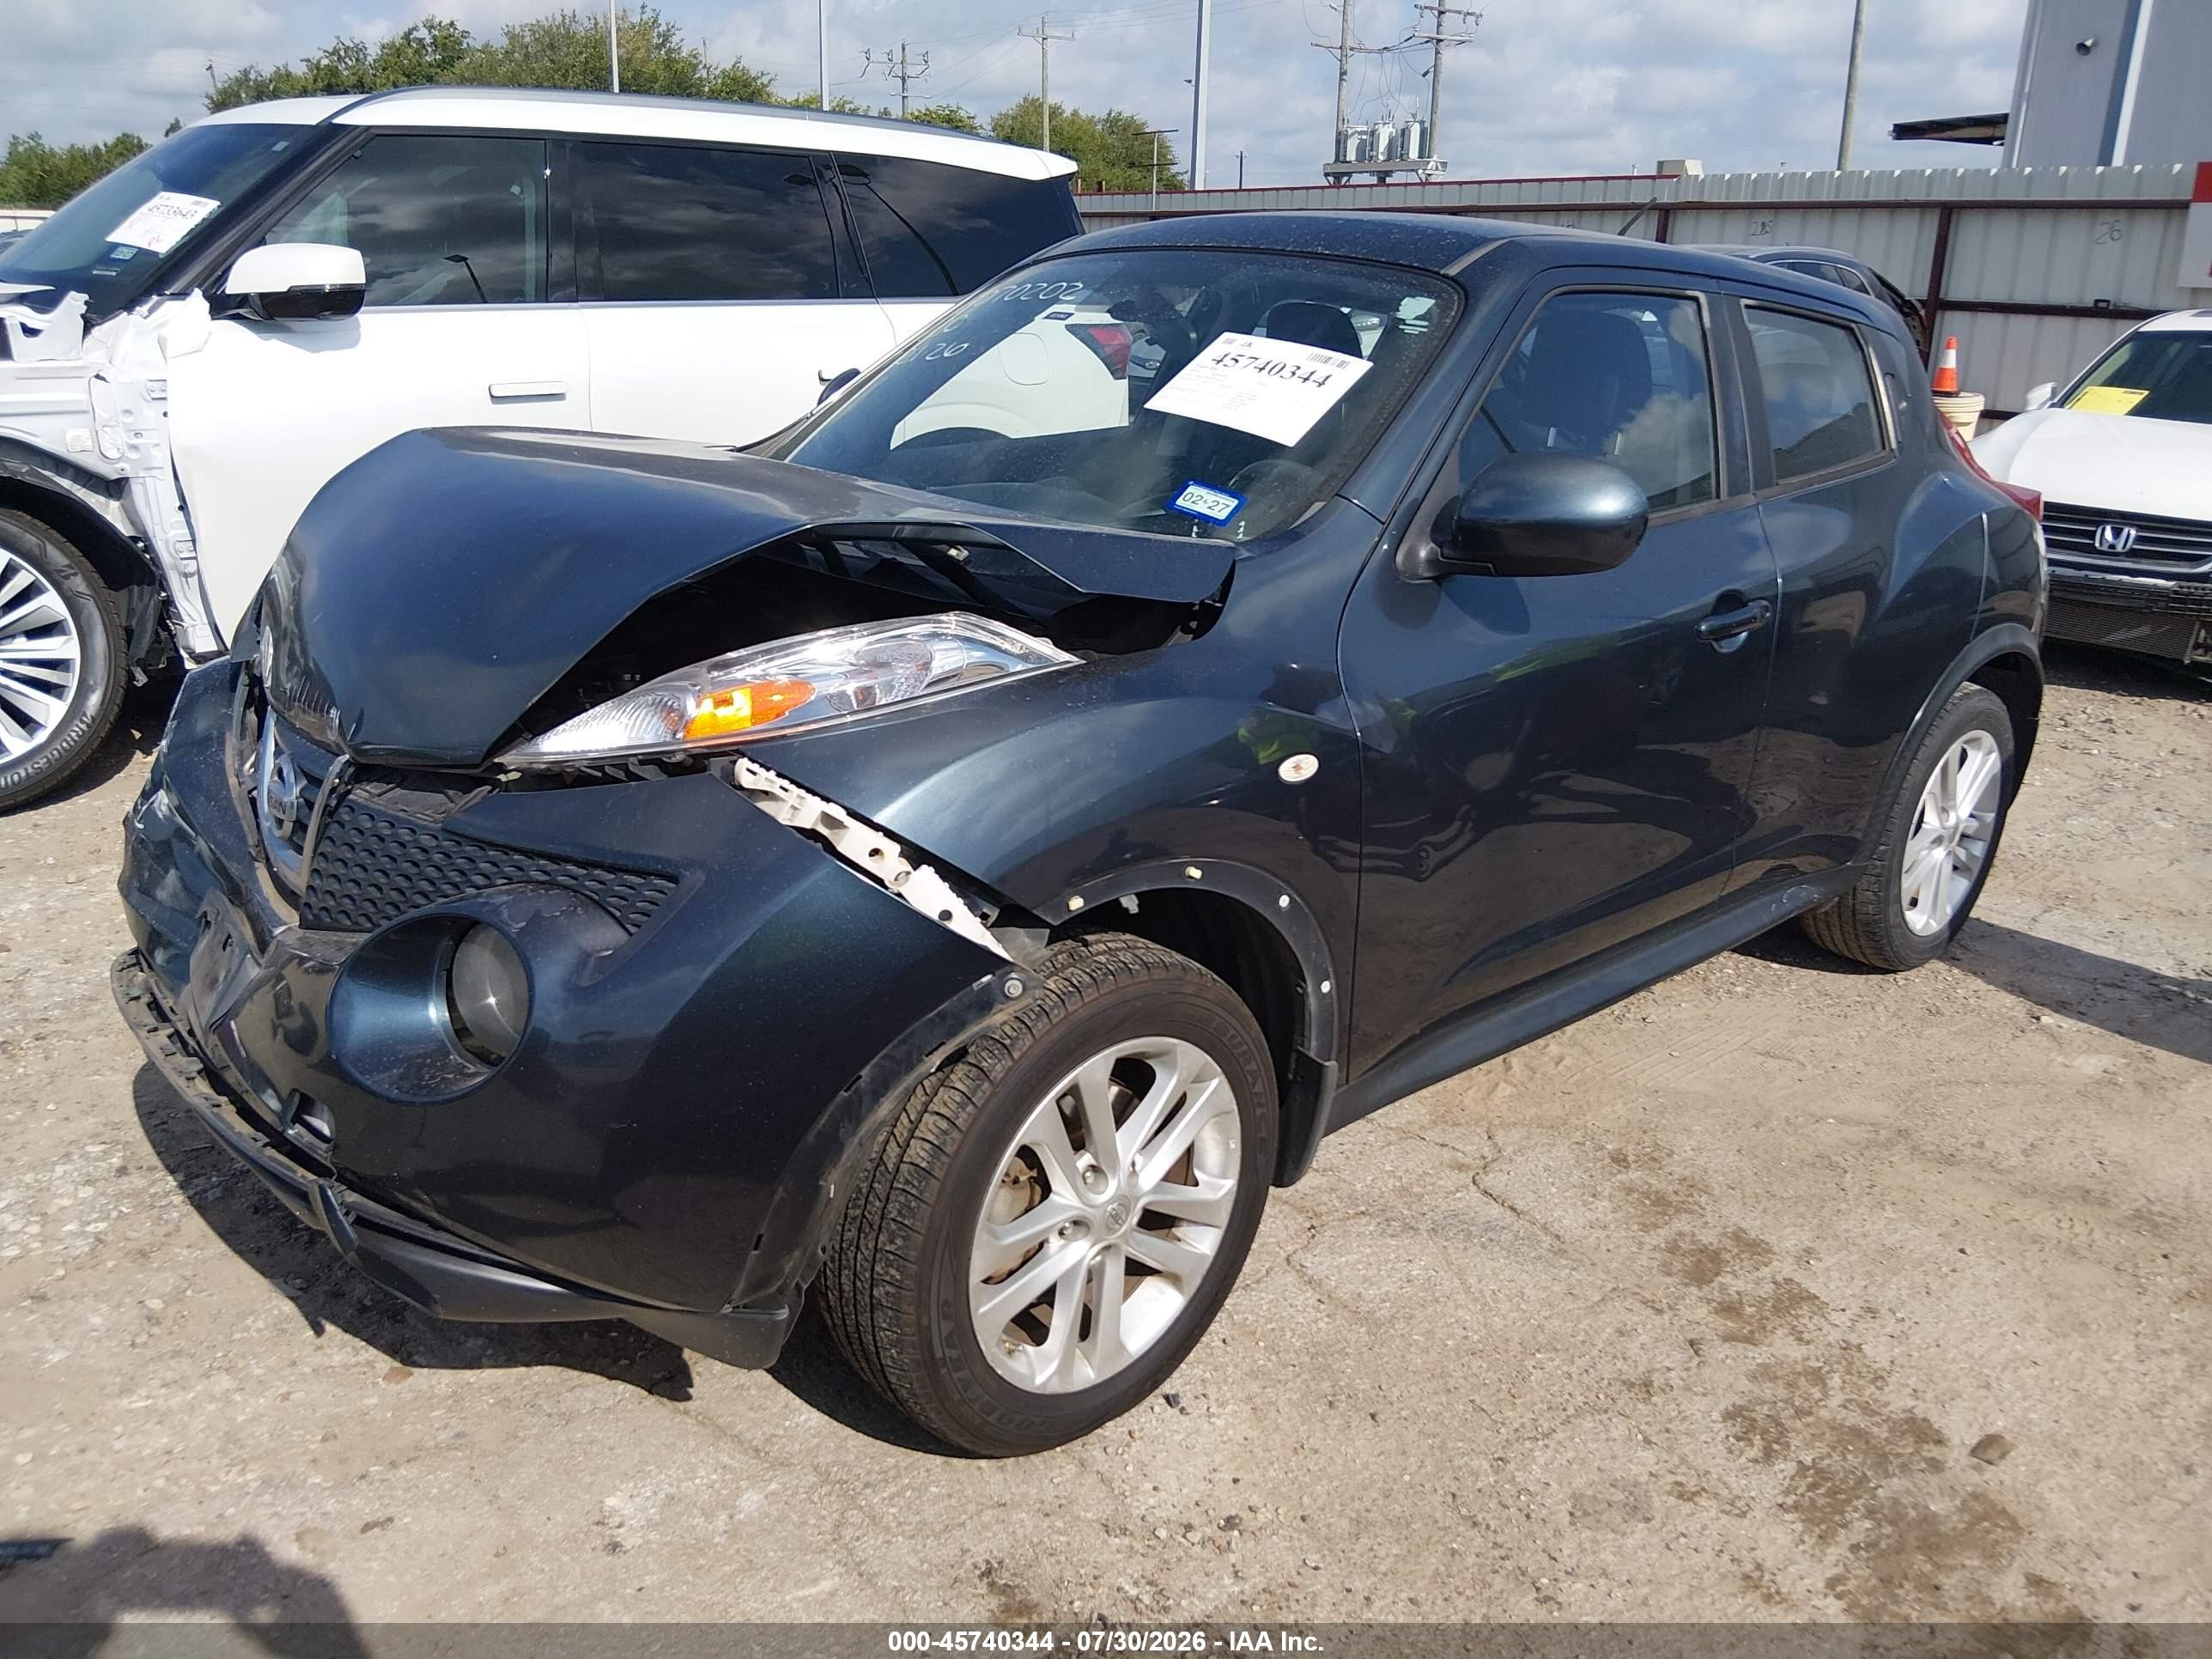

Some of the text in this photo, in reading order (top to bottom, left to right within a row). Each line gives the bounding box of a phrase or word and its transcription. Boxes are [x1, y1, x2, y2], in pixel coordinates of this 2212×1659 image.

[2095, 220, 2124, 246] 26
[1211, 351, 1334, 388] 45740344
[1182, 491, 1204, 506] 02
[1206, 499, 1231, 514] 27
